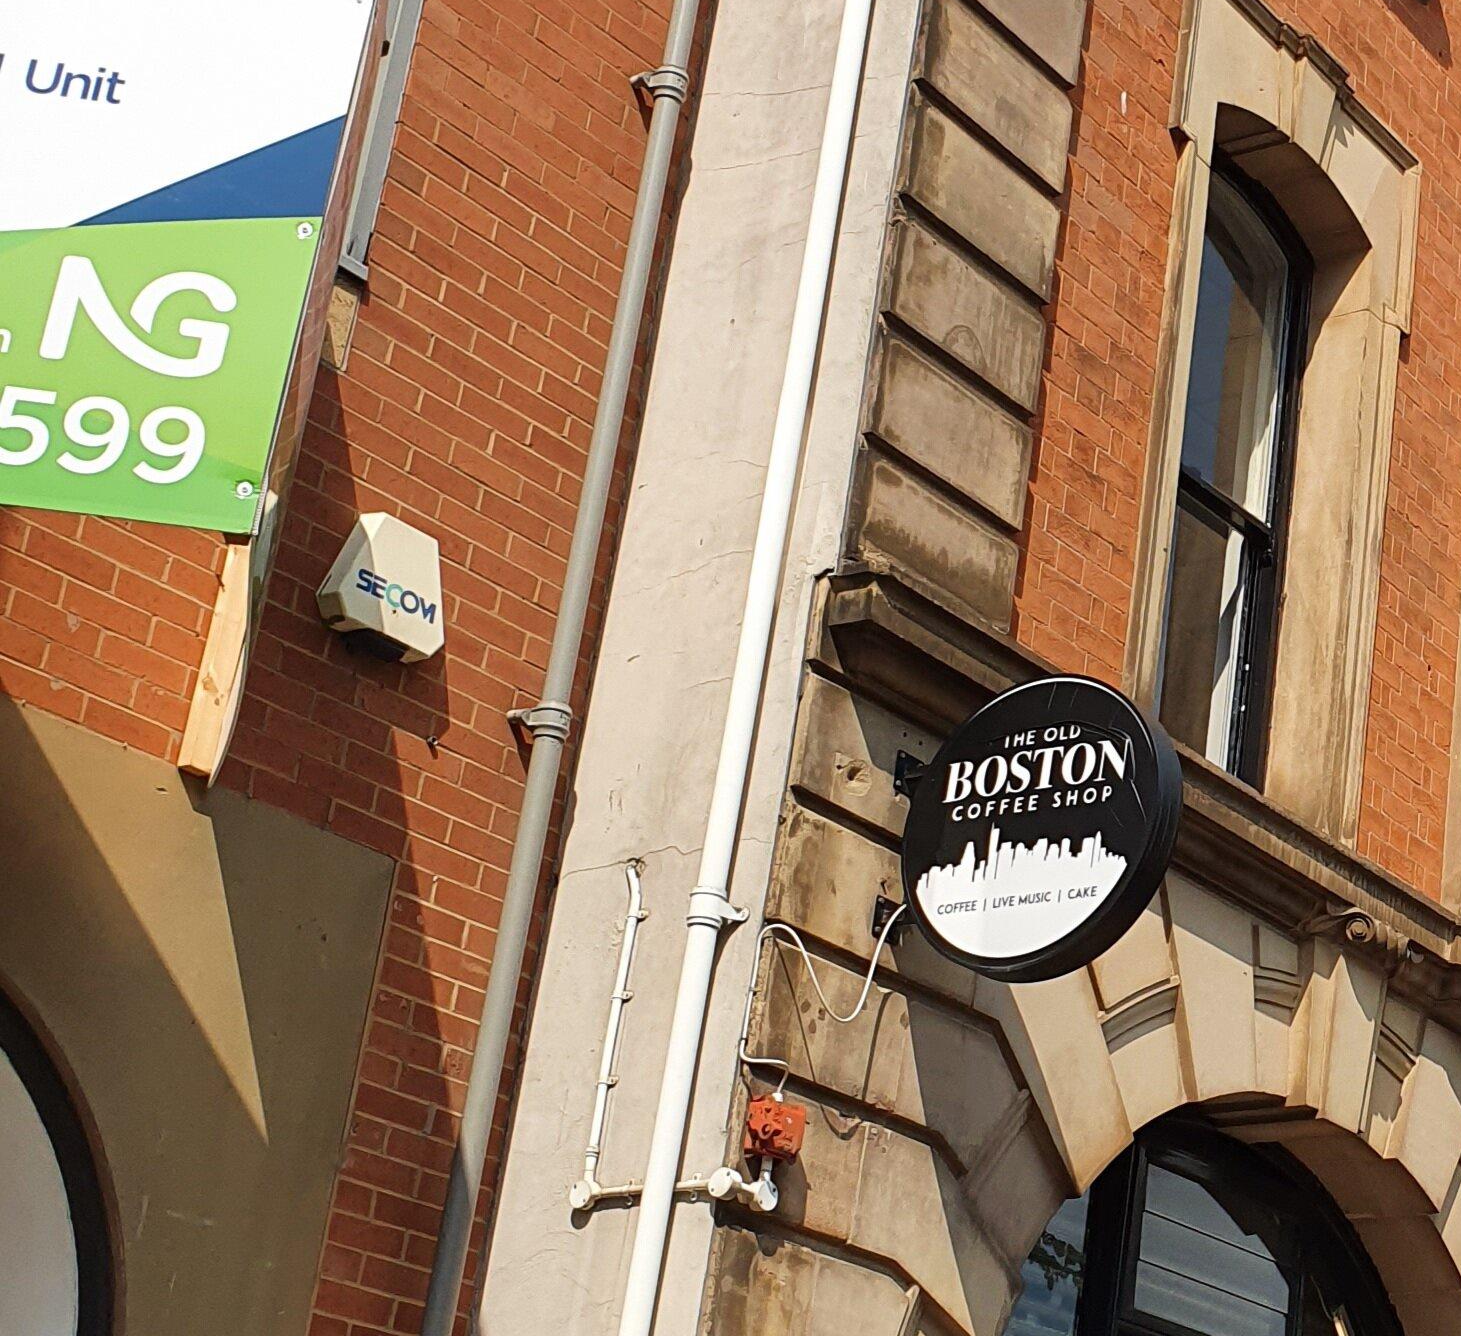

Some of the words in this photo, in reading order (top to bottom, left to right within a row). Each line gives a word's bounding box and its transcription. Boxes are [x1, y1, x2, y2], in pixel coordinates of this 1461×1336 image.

[25, 59, 125, 104] Unit
[39, 255, 237, 377] NG
[356, 568, 437, 624] SECOM
[1043, 725, 1081, 742] OLD
[942, 738, 1131, 804] BOSTON
[951, 794, 1039, 822] COFFEE
[1052, 785, 1113, 808] SHOP
[937, 900, 978, 915] COFFEE
[992, 895, 1016, 909] LIVE
[1018, 891, 1052, 906] MUSIC
[1067, 885, 1098, 900] CAKE
